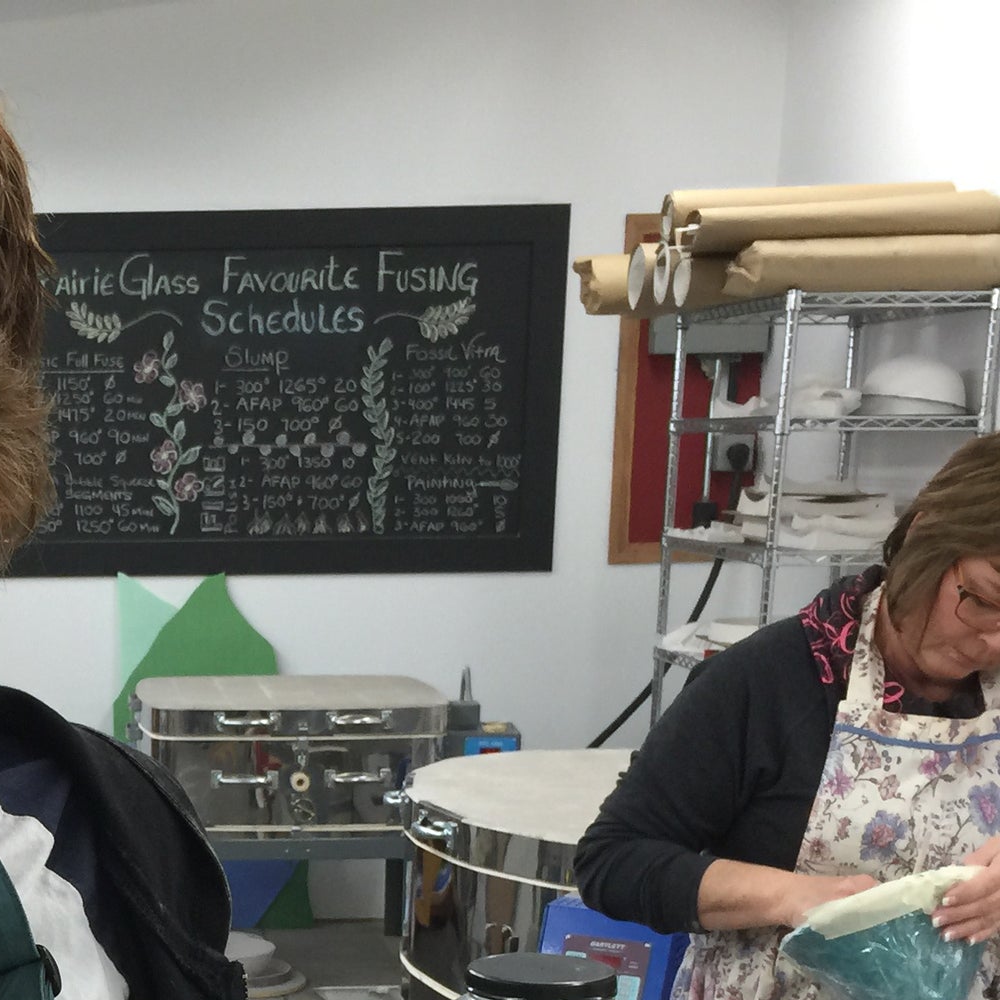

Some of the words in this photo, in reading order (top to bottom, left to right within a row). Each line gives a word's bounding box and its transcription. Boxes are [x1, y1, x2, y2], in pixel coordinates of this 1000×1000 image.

[377, 251, 478, 296] FUSING
[334, 378, 357, 394] 20
[236, 397, 283, 412] AFAP
[334, 400, 359, 412] 60
[104, 409, 126, 423] 20
[238, 418, 268, 432] 150
[107, 428, 131, 445] 90
[340, 476, 363, 489] 60
[117, 519, 137, 533] 60
